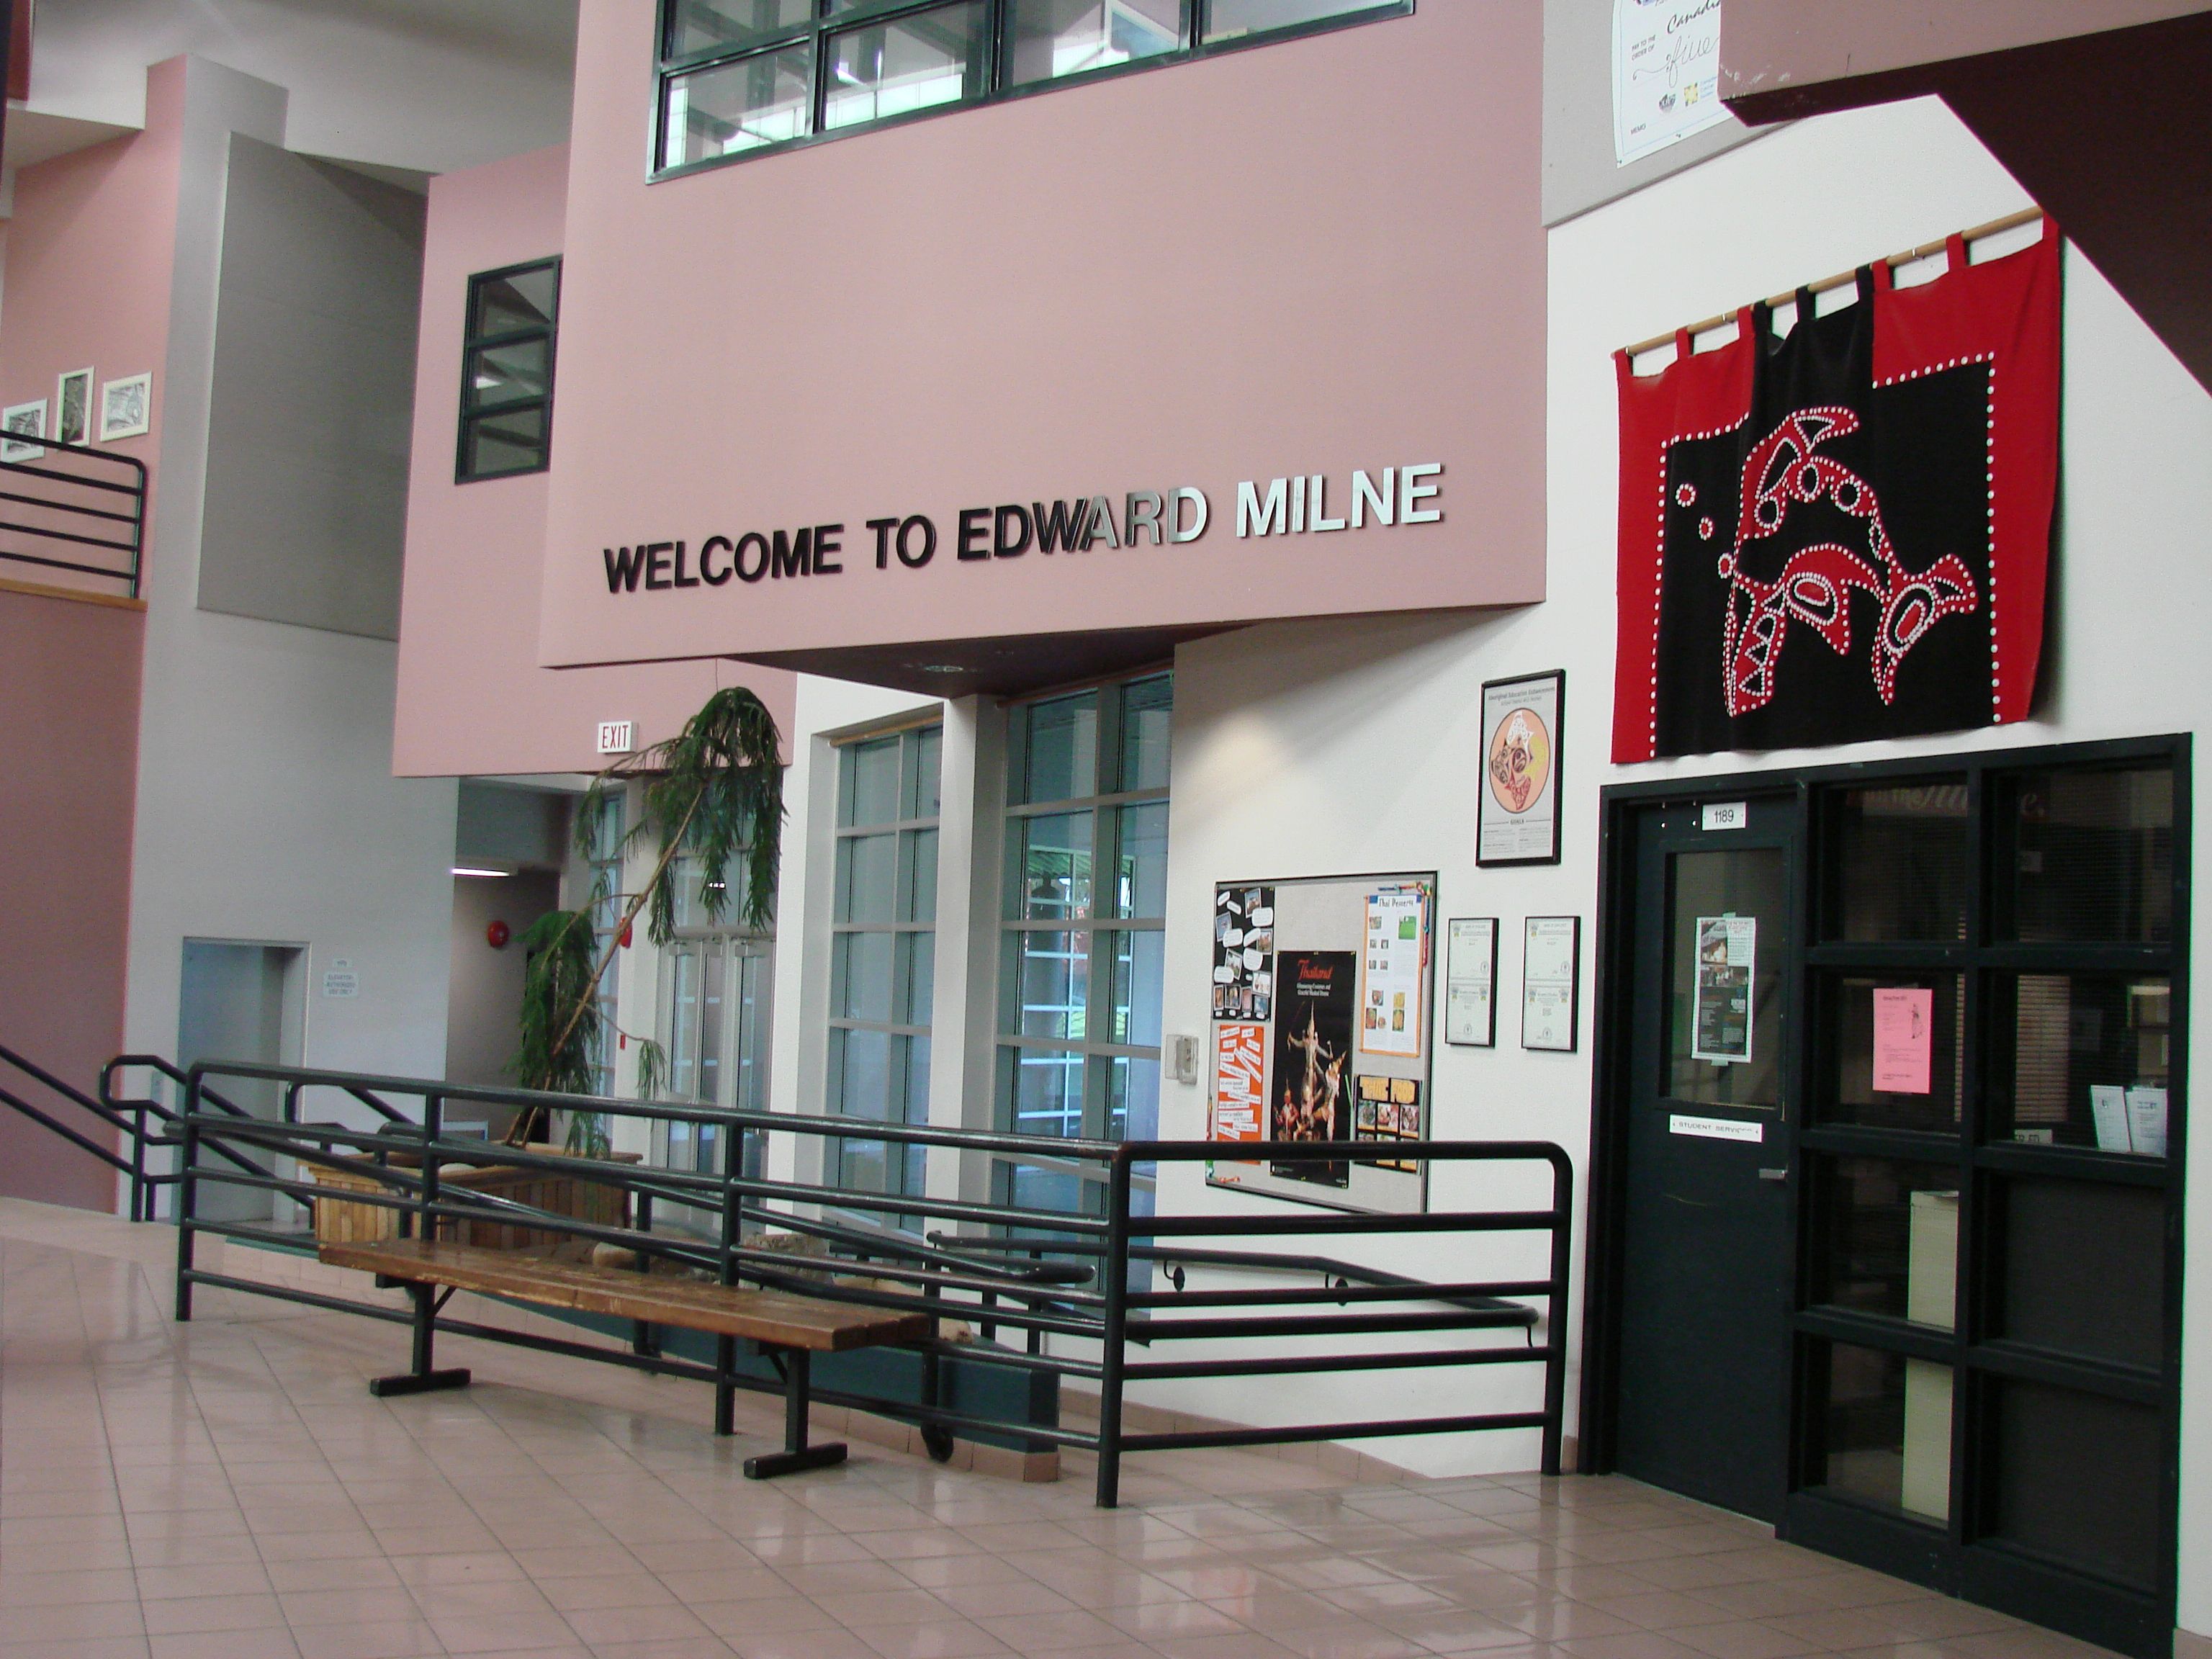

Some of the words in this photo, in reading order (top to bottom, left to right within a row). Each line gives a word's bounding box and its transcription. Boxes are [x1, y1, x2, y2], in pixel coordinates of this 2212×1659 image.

[1630, 123, 1647, 135] MEMO
[603, 523, 844, 593] WELCOME
[866, 514, 938, 570] TO
[957, 485, 1210, 562] EDWARD
[1236, 462, 1444, 539] MILNE
[602, 724, 629, 749] EXIT
[1714, 810, 1734, 824] 1189
[1297, 959, 1333, 981] Thailand
[1678, 1121, 1711, 1130] STUDENT
